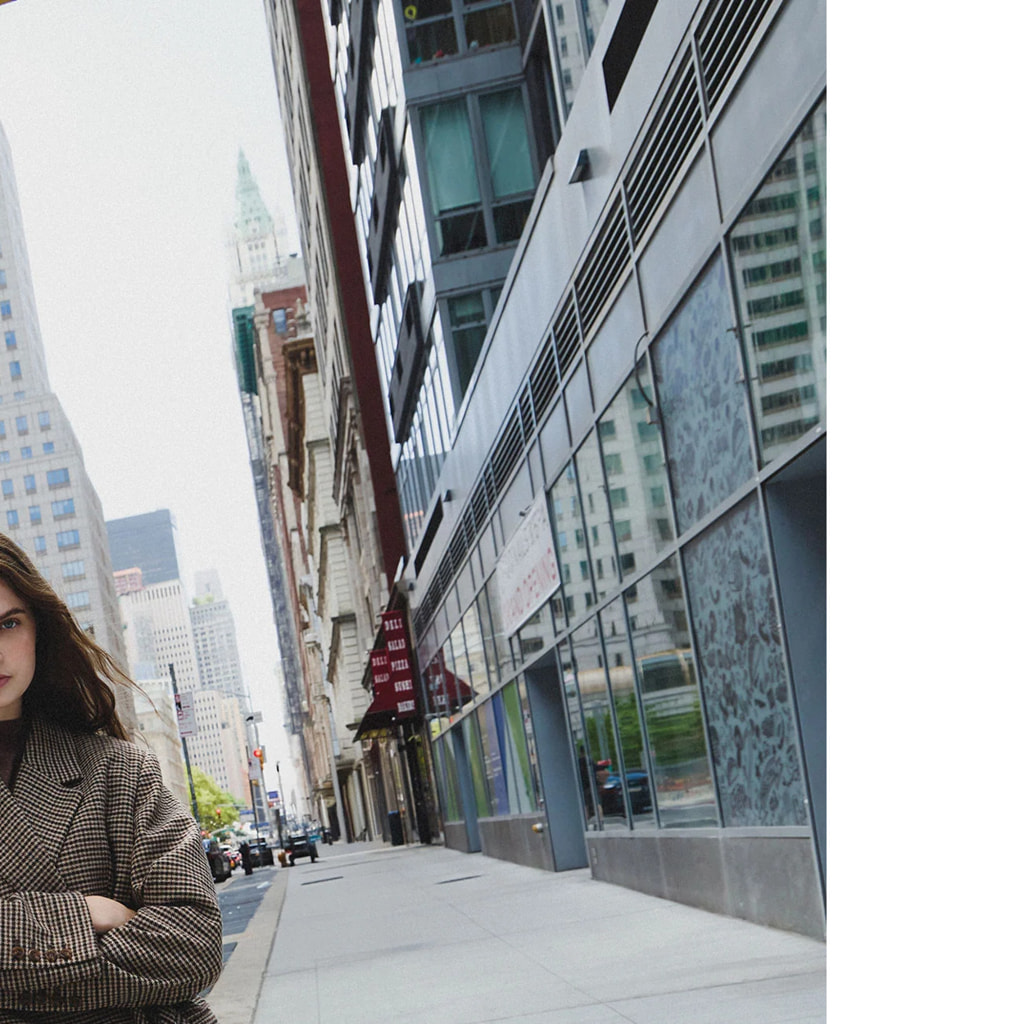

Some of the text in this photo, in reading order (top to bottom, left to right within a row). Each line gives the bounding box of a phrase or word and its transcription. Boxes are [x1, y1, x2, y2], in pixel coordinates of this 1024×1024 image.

[384, 618, 403, 631] DELI
[387, 638, 406, 651] SALAD
[371, 656, 388, 667] DELI
[390, 658, 409, 672] PIZZA
[394, 679, 413, 693] SUSHI
